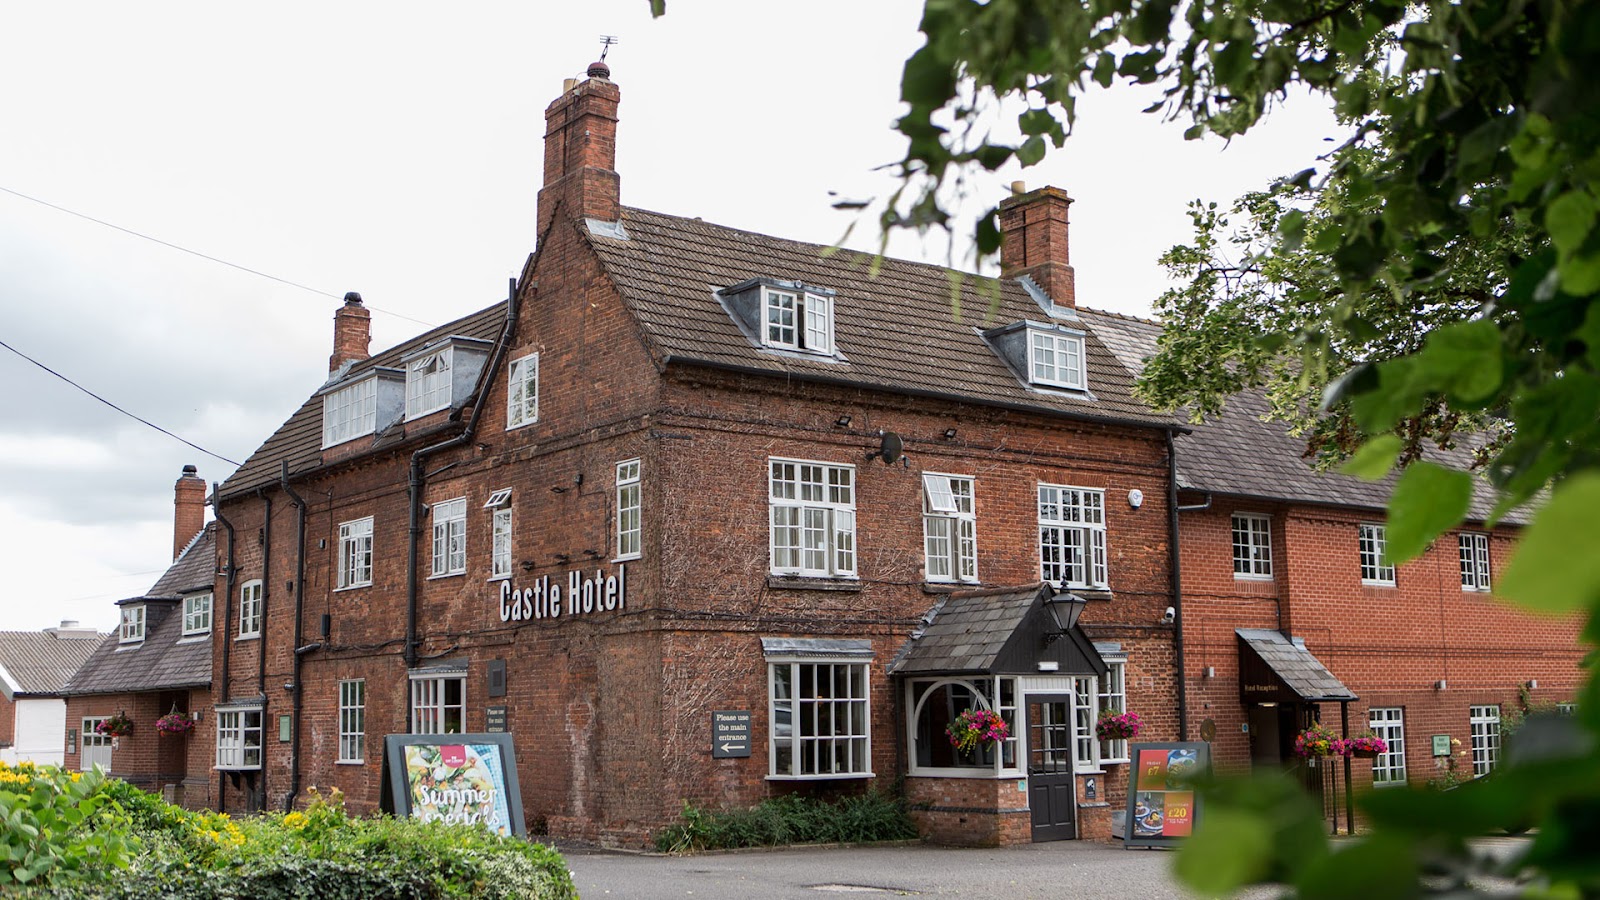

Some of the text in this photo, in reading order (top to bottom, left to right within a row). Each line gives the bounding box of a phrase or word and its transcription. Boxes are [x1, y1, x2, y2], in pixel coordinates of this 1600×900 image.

[500, 564, 625, 622] Castle Hotel
[1147, 766, 1160, 776] £7
[420, 784, 498, 806] Summer
[1168, 807, 1187, 818] £20
